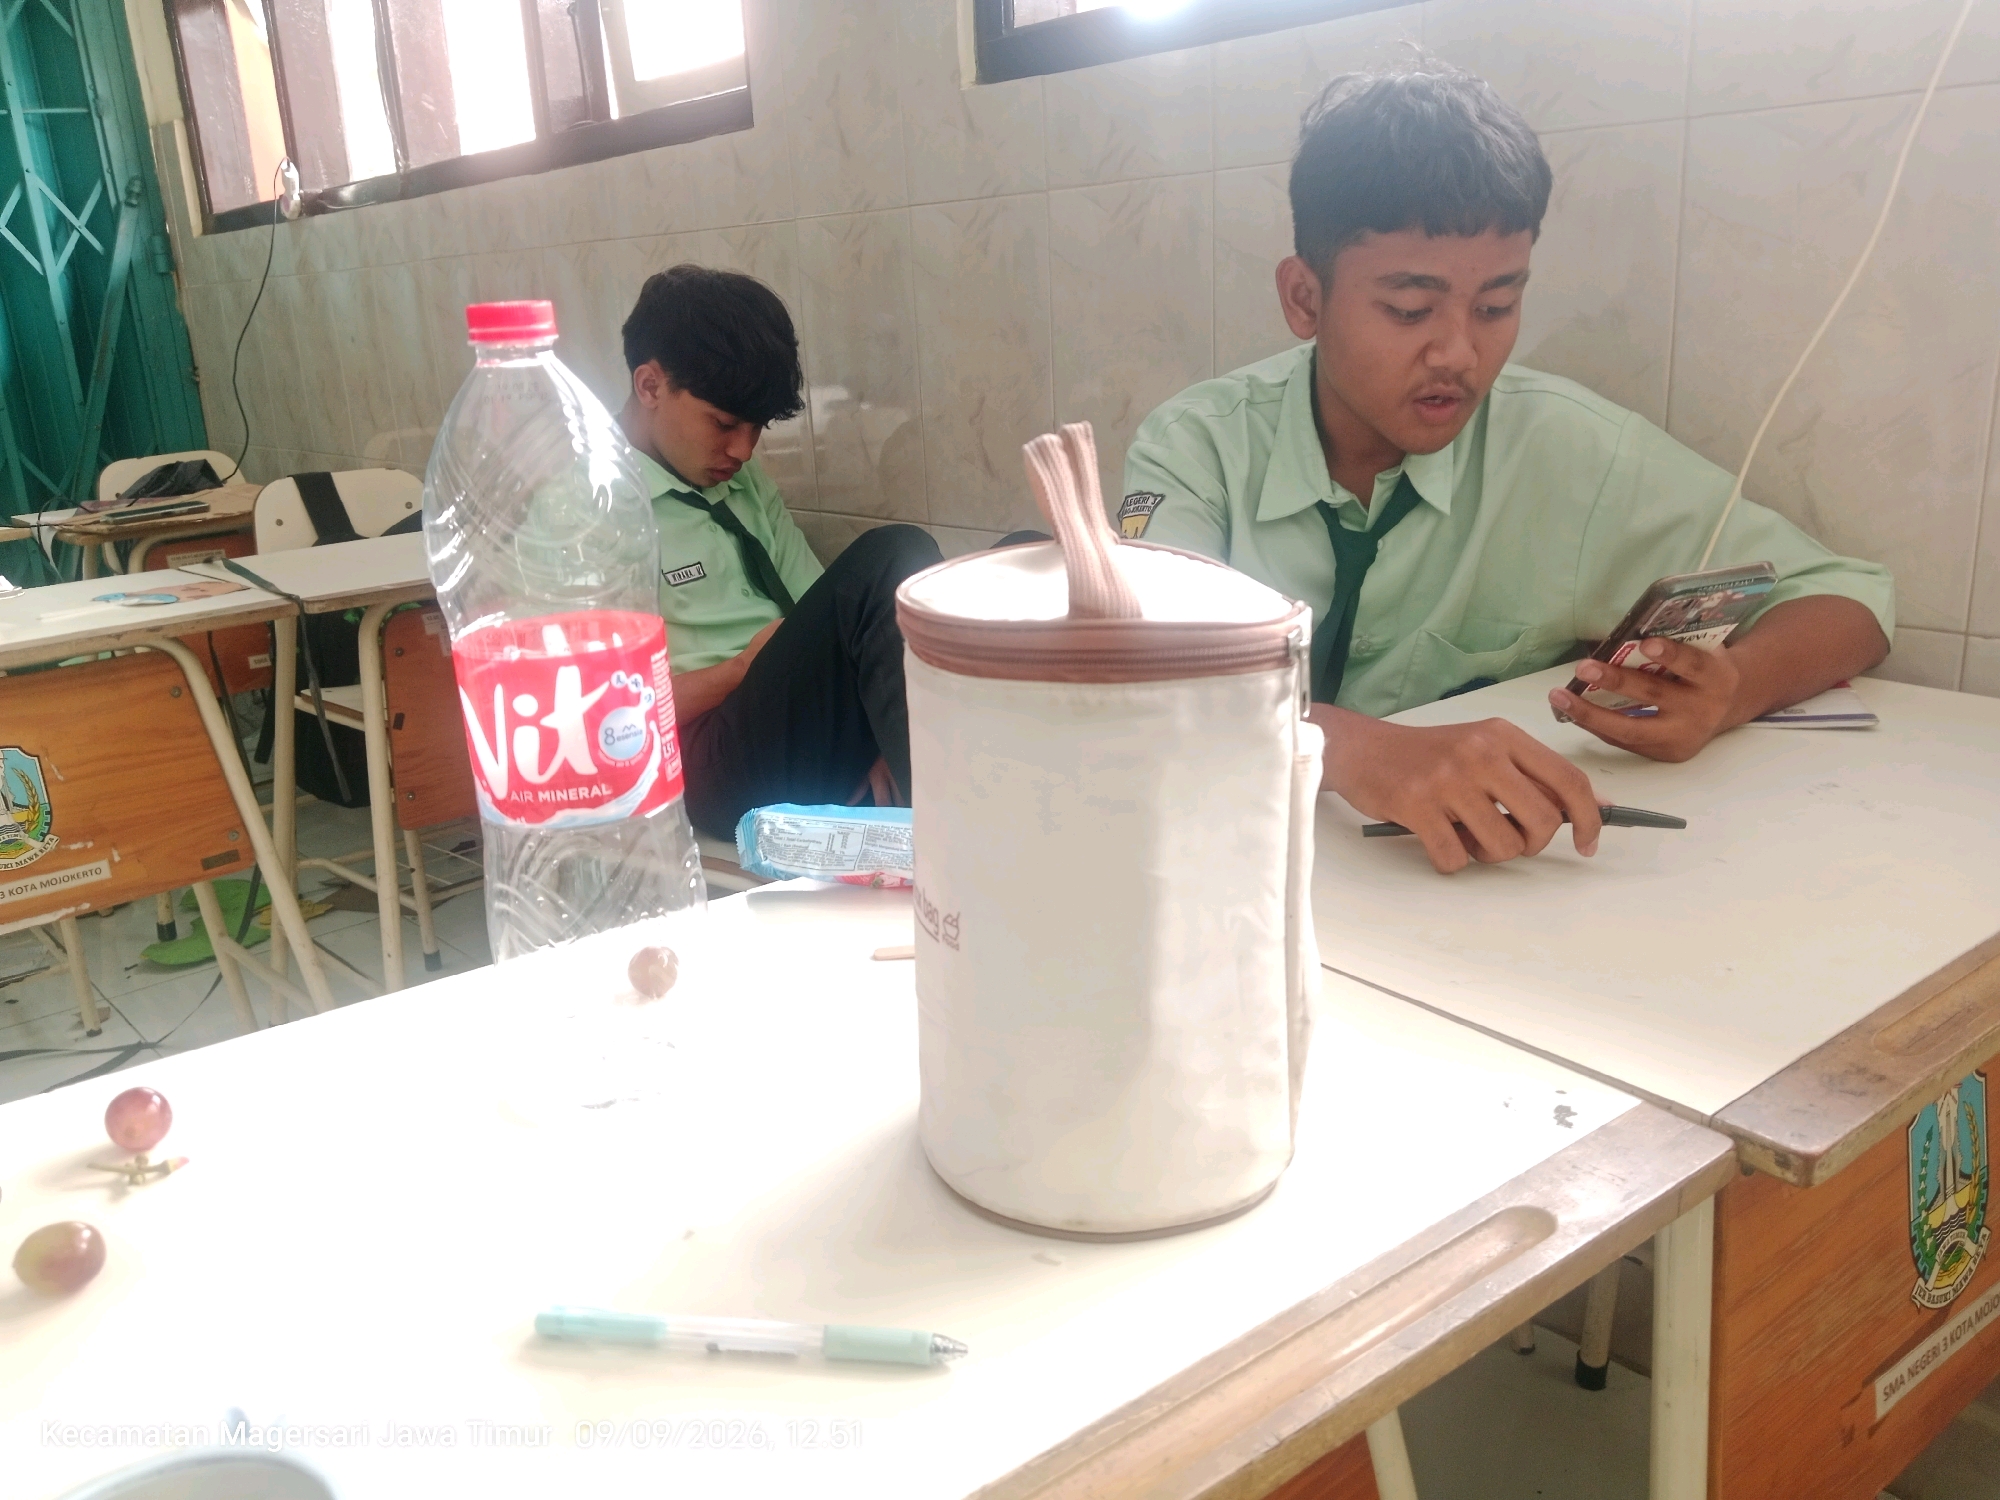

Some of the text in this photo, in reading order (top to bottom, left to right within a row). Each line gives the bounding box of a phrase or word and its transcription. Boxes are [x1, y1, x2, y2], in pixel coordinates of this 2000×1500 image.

[458, 665, 610, 800] Vit
[604, 727, 616, 746] 8
[510, 784, 612, 803] AIR MINERAL
[15, 852, 40, 868] MAWA
[8, 883, 38, 897] KOTA
[39, 866, 102, 889] MOJOKERTO
[1882, 1373, 1906, 1402] SMA
[1907, 1342, 1941, 1378] NEGERI
[1941, 1336, 1949, 1352] 3
[1949, 1316, 1974, 1346] KOTA
